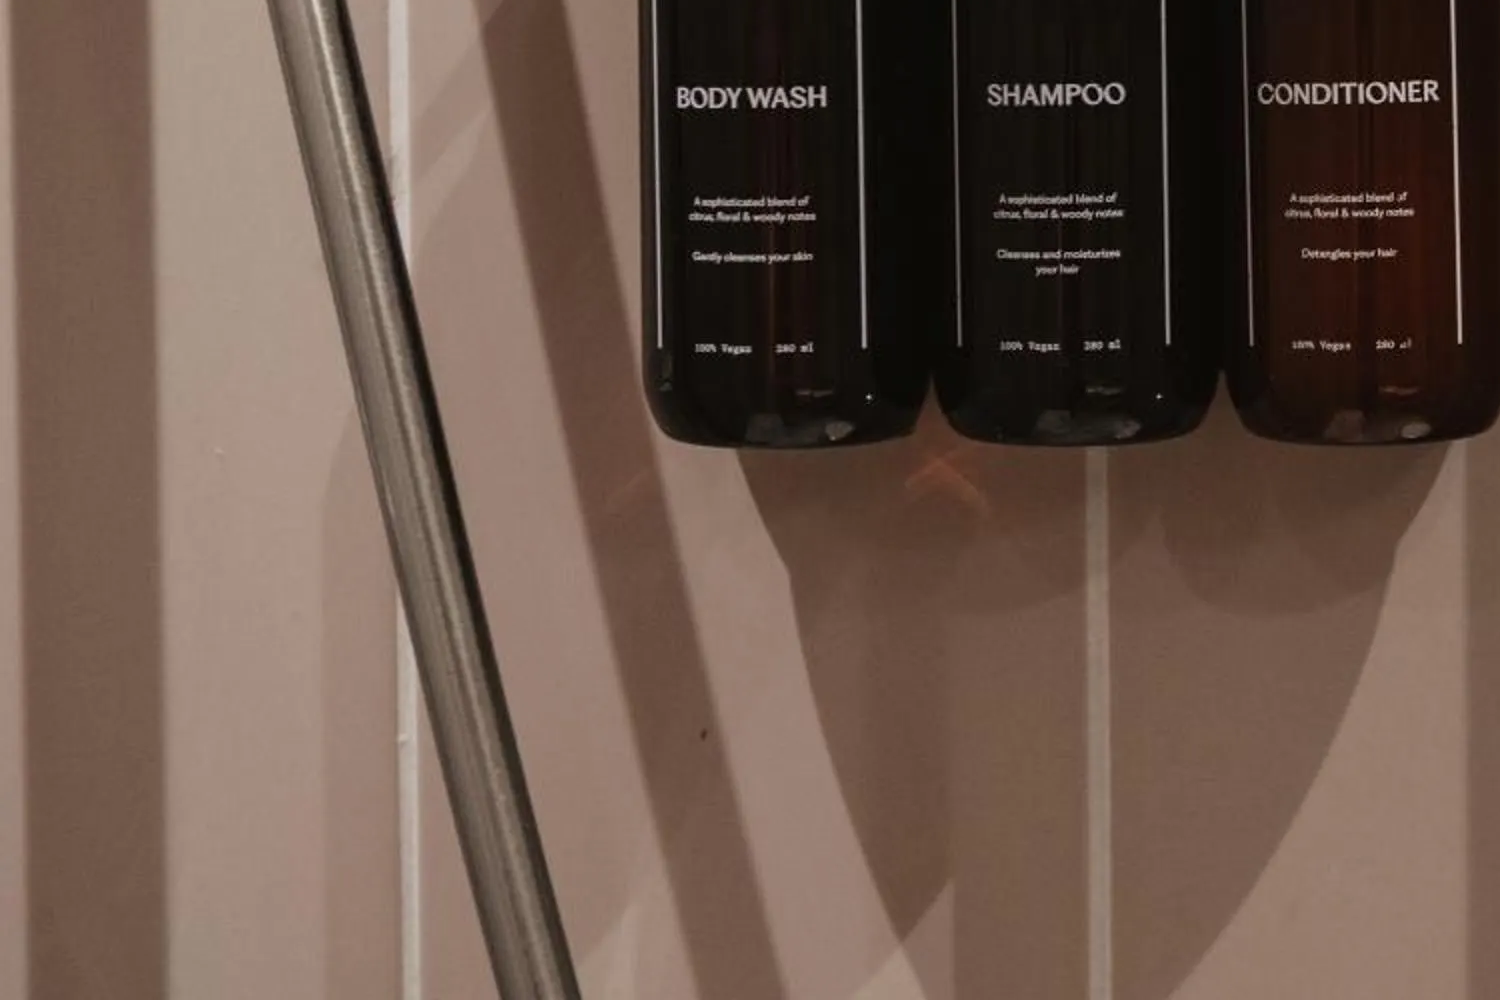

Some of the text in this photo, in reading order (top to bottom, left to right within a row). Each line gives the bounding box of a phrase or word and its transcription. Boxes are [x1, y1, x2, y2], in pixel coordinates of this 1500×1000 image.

[676, 85, 827, 109] BODY WASH
[986, 82, 1126, 106] SHAMPOO
[1257, 79, 1440, 105] CONDITIONER
[693, 195, 701, 207] A
[766, 195, 797, 207] blend
[797, 195, 811, 207] of
[999, 193, 1007, 204] A
[1075, 193, 1104, 204] blend
[1105, 191, 1118, 203] of
[1289, 193, 1298, 203] A
[1366, 192, 1395, 203] blend
[1396, 191, 1409, 202] of
[752, 212, 785, 224] woody
[1050, 209, 1060, 219] &
[1060, 208, 1093, 221] woody
[1095, 208, 1125, 218] notes
[1313, 207, 1339, 218] floral
[1350, 207, 1384, 220] woody
[1385, 208, 1415, 217] notes
[691, 251, 814, 264] Gently cleanses your skin
[996, 248, 1041, 260] Cleanses
[1042, 248, 1062, 260] and
[1300, 247, 1399, 262] Detangles your hair
[1034, 264, 1080, 277] your hair
